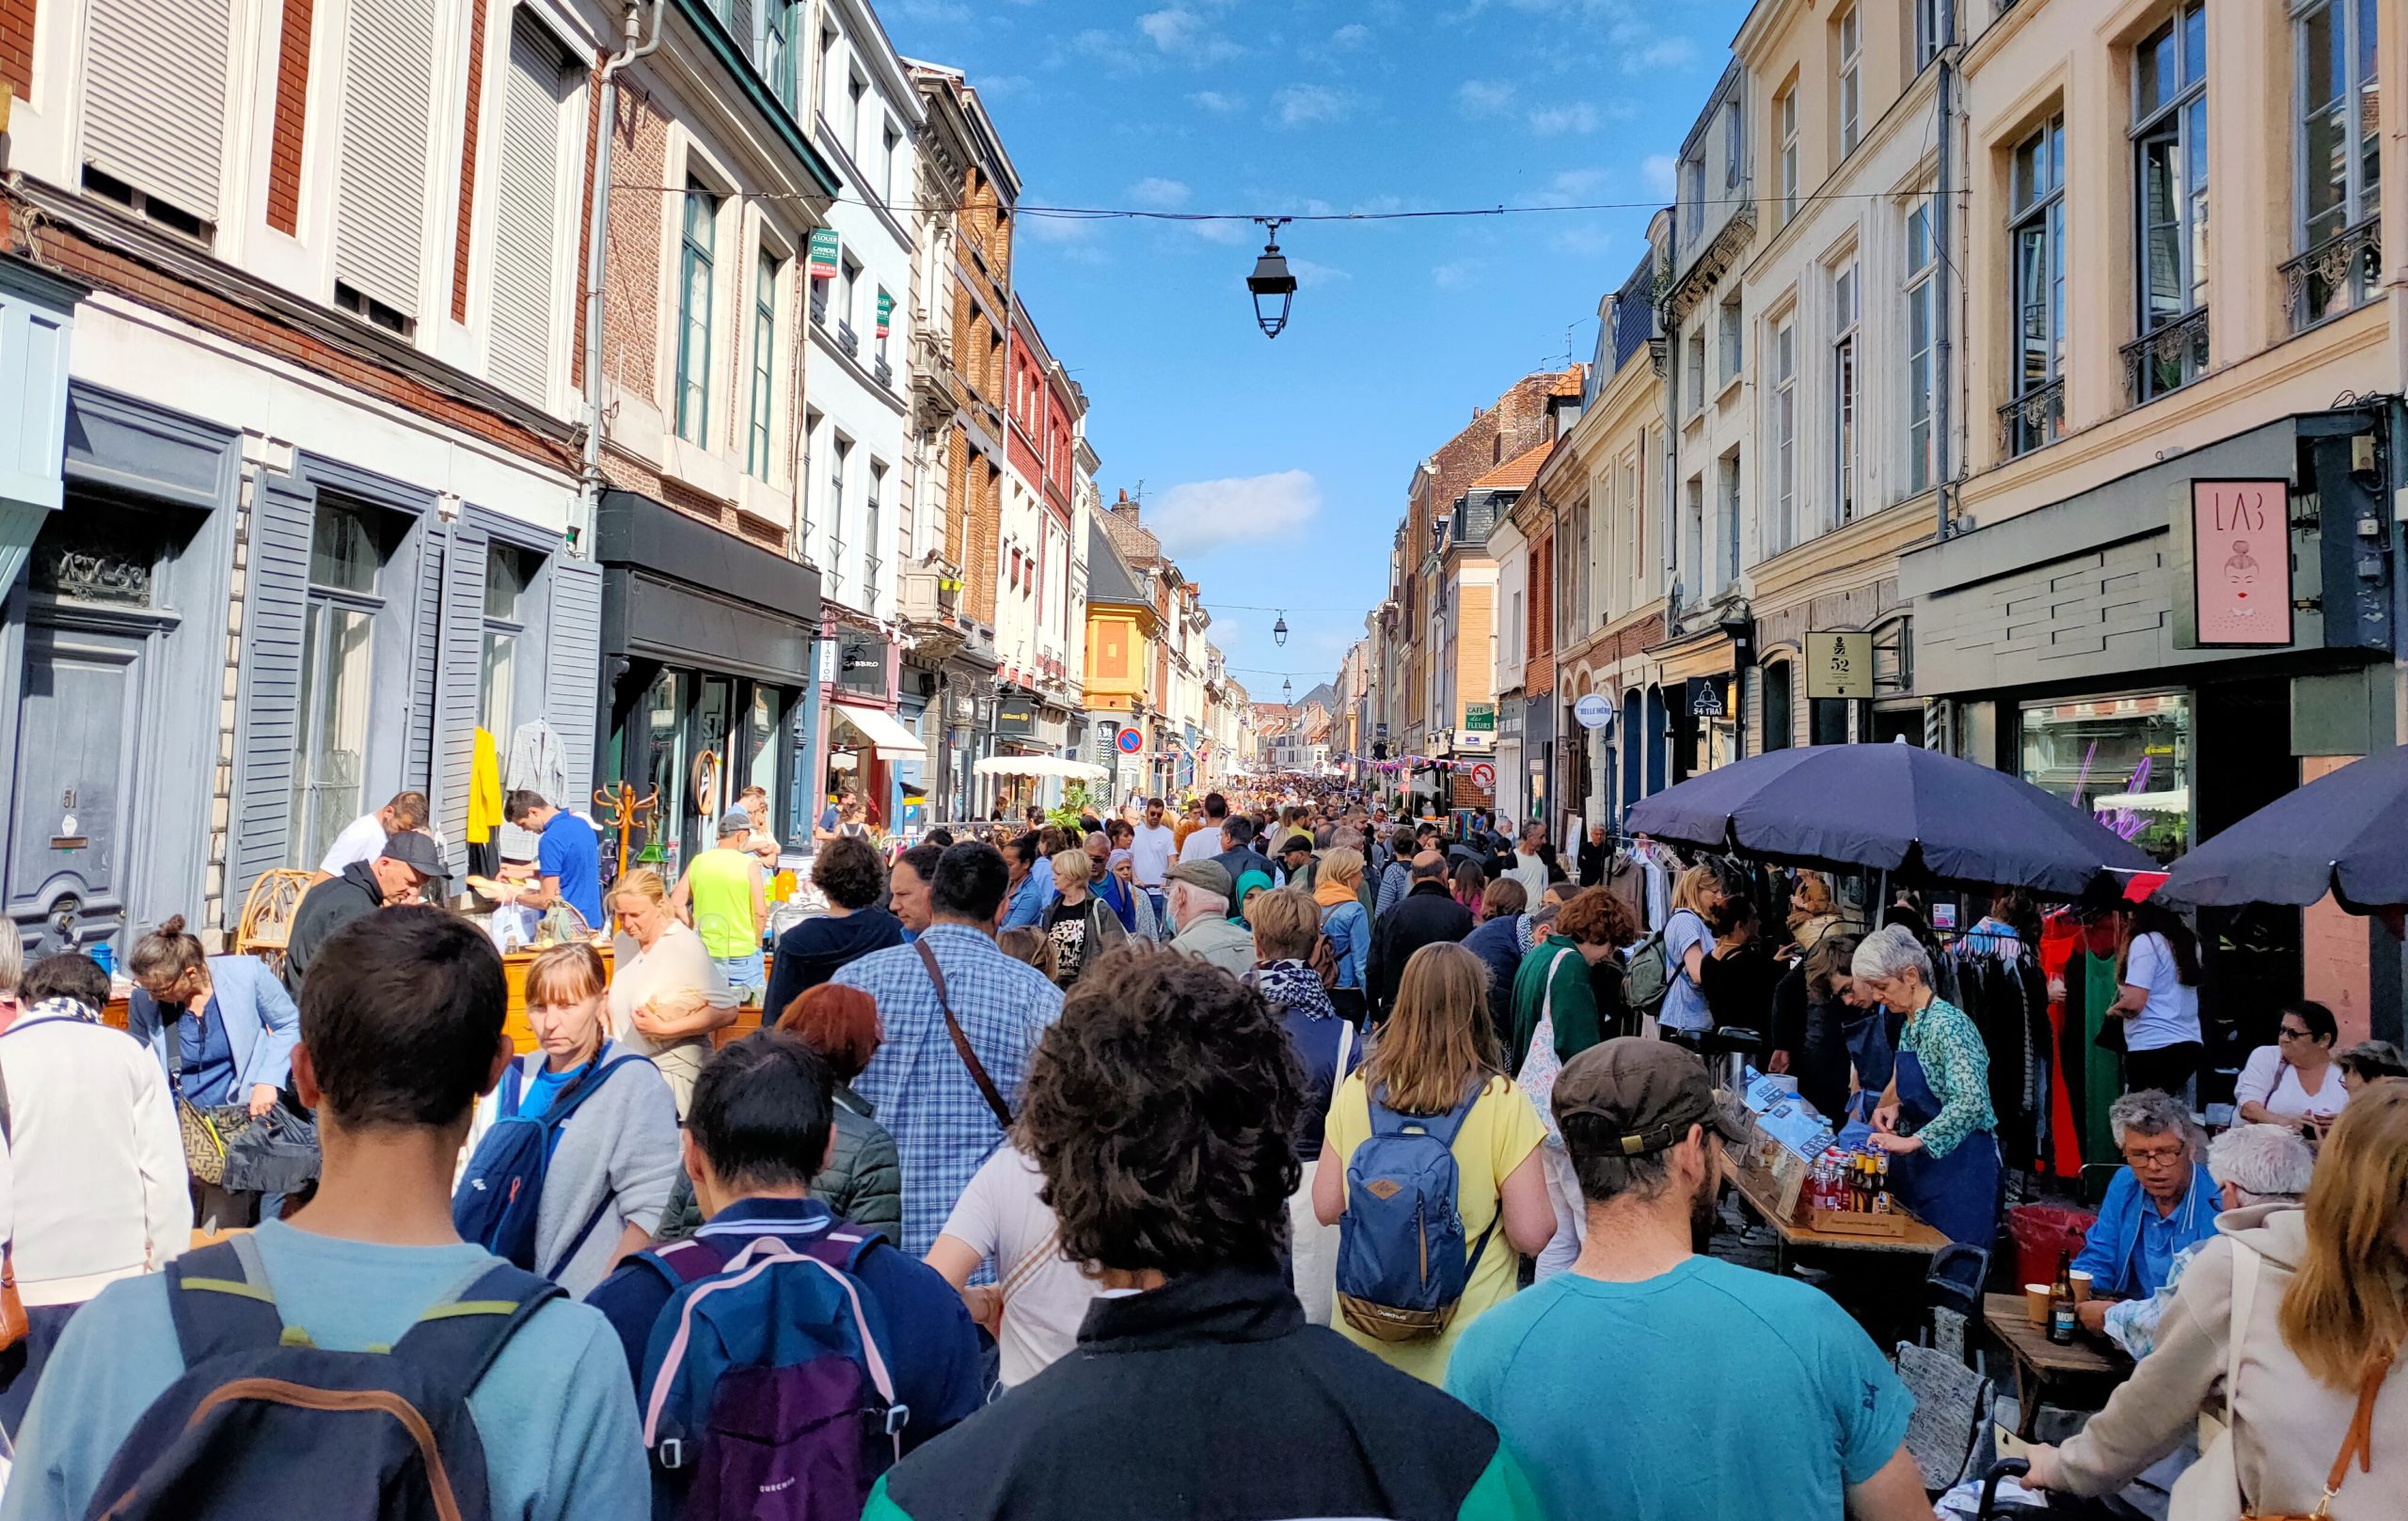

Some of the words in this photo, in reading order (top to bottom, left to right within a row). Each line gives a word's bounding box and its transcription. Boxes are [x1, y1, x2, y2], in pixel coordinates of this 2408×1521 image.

[818, 235, 837, 244] LOUER
[2215, 492, 2264, 531] LAB
[1831, 658, 1849, 672] 52
[63, 789, 76, 809] 51
